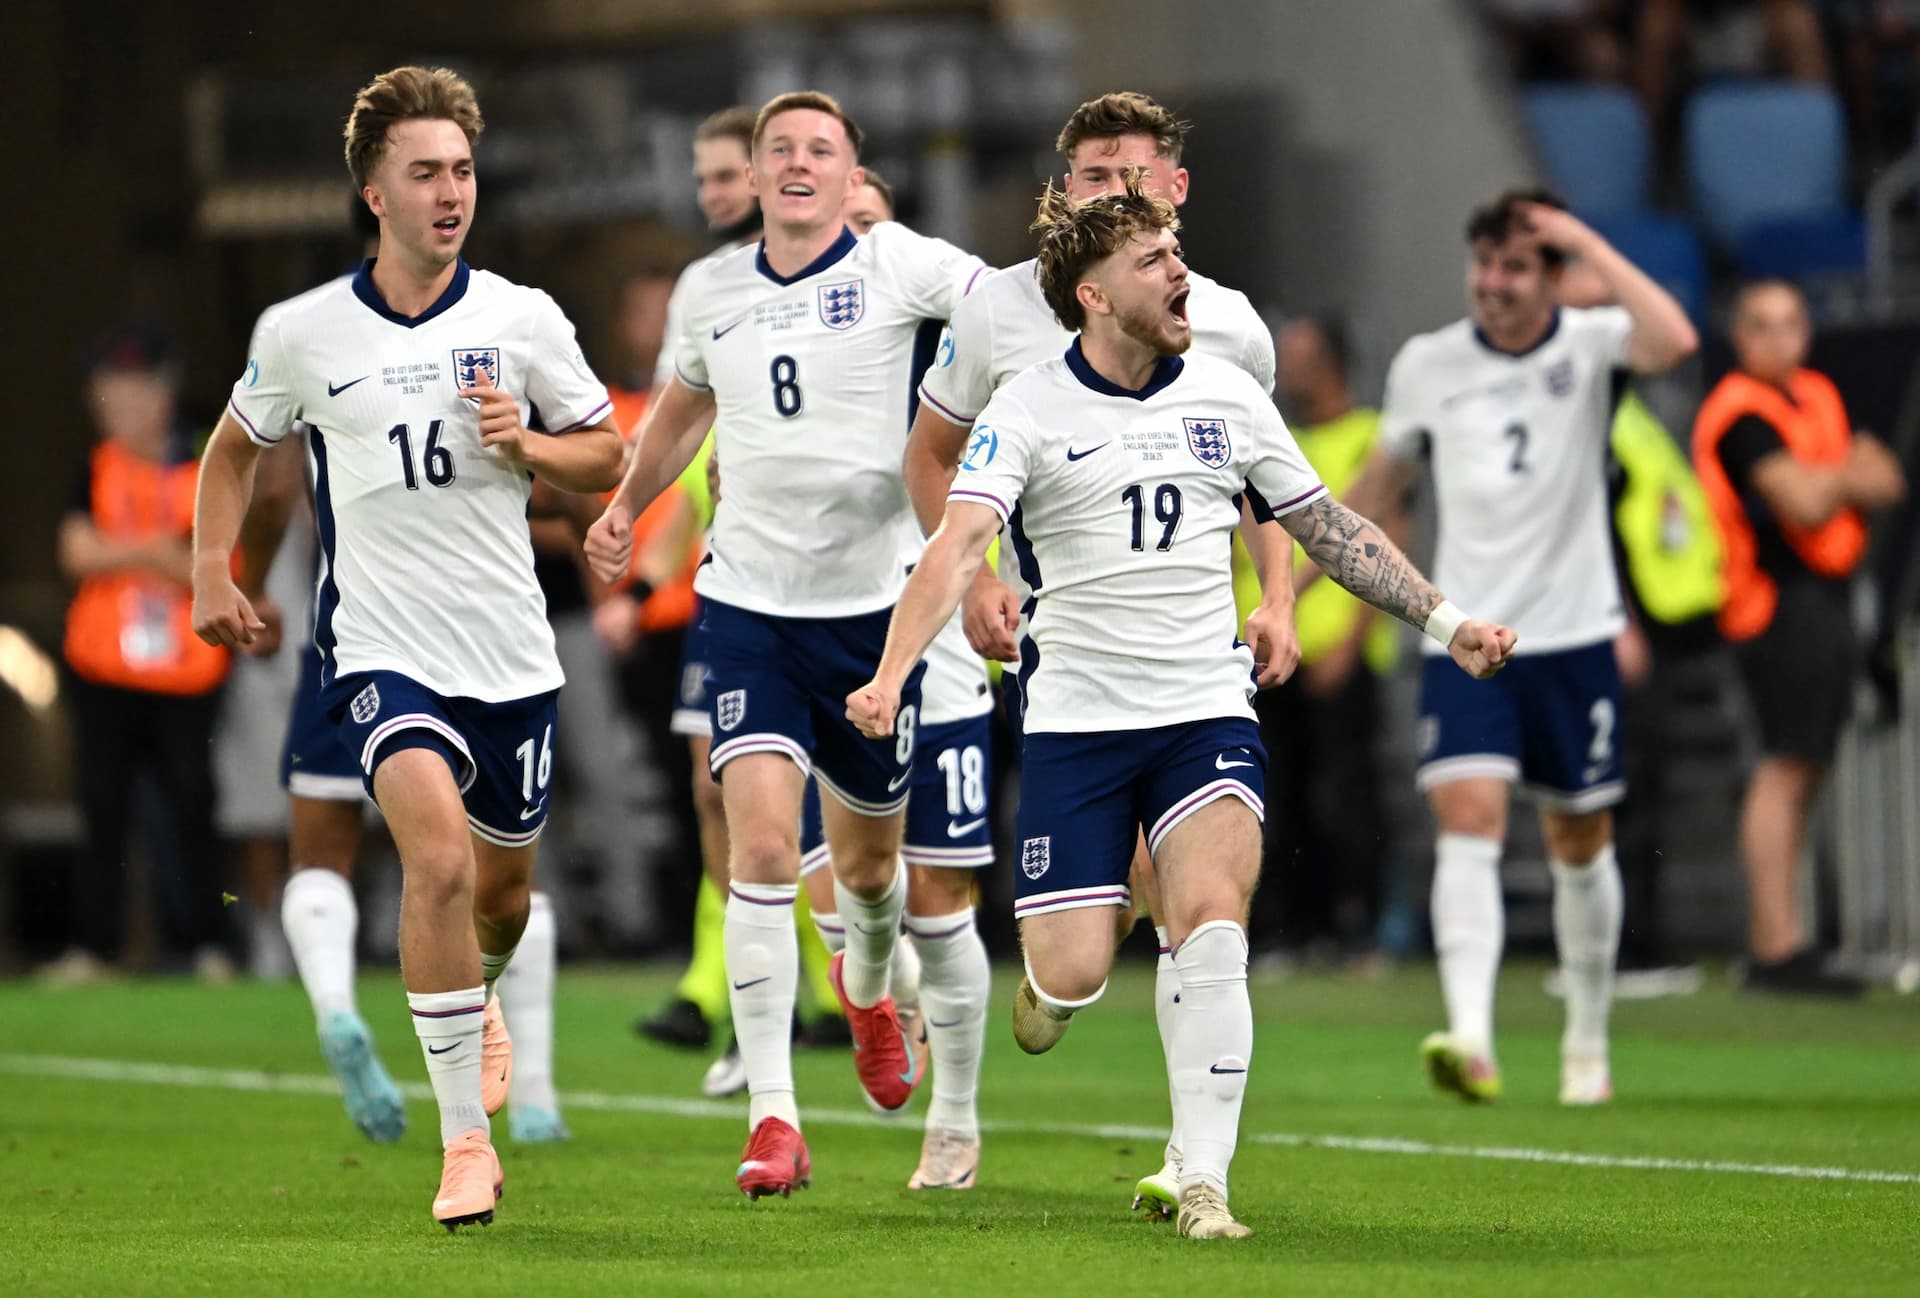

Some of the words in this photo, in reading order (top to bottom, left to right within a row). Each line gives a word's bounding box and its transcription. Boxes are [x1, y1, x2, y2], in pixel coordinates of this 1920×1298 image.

[382, 367, 395, 375] UEFA
[408, 364, 423, 373] EURO
[424, 362, 440, 371] FINAL
[383, 376, 408, 385] ENGLAND
[415, 373, 440, 383] GERMANY
[769, 354, 805, 419] 8
[388, 419, 457, 490] 16
[1123, 442, 1148, 450] ENGLAND
[1154, 442, 1179, 450] GERMANY
[1147, 431, 1162, 440] EURO
[1163, 431, 1178, 440] FINAL
[1504, 421, 1534, 474] 2
[1121, 483, 1184, 552] 19
[895, 704, 916, 765] 8
[1588, 697, 1616, 760] 2
[516, 723, 552, 801] 16
[937, 745, 987, 815] 18
